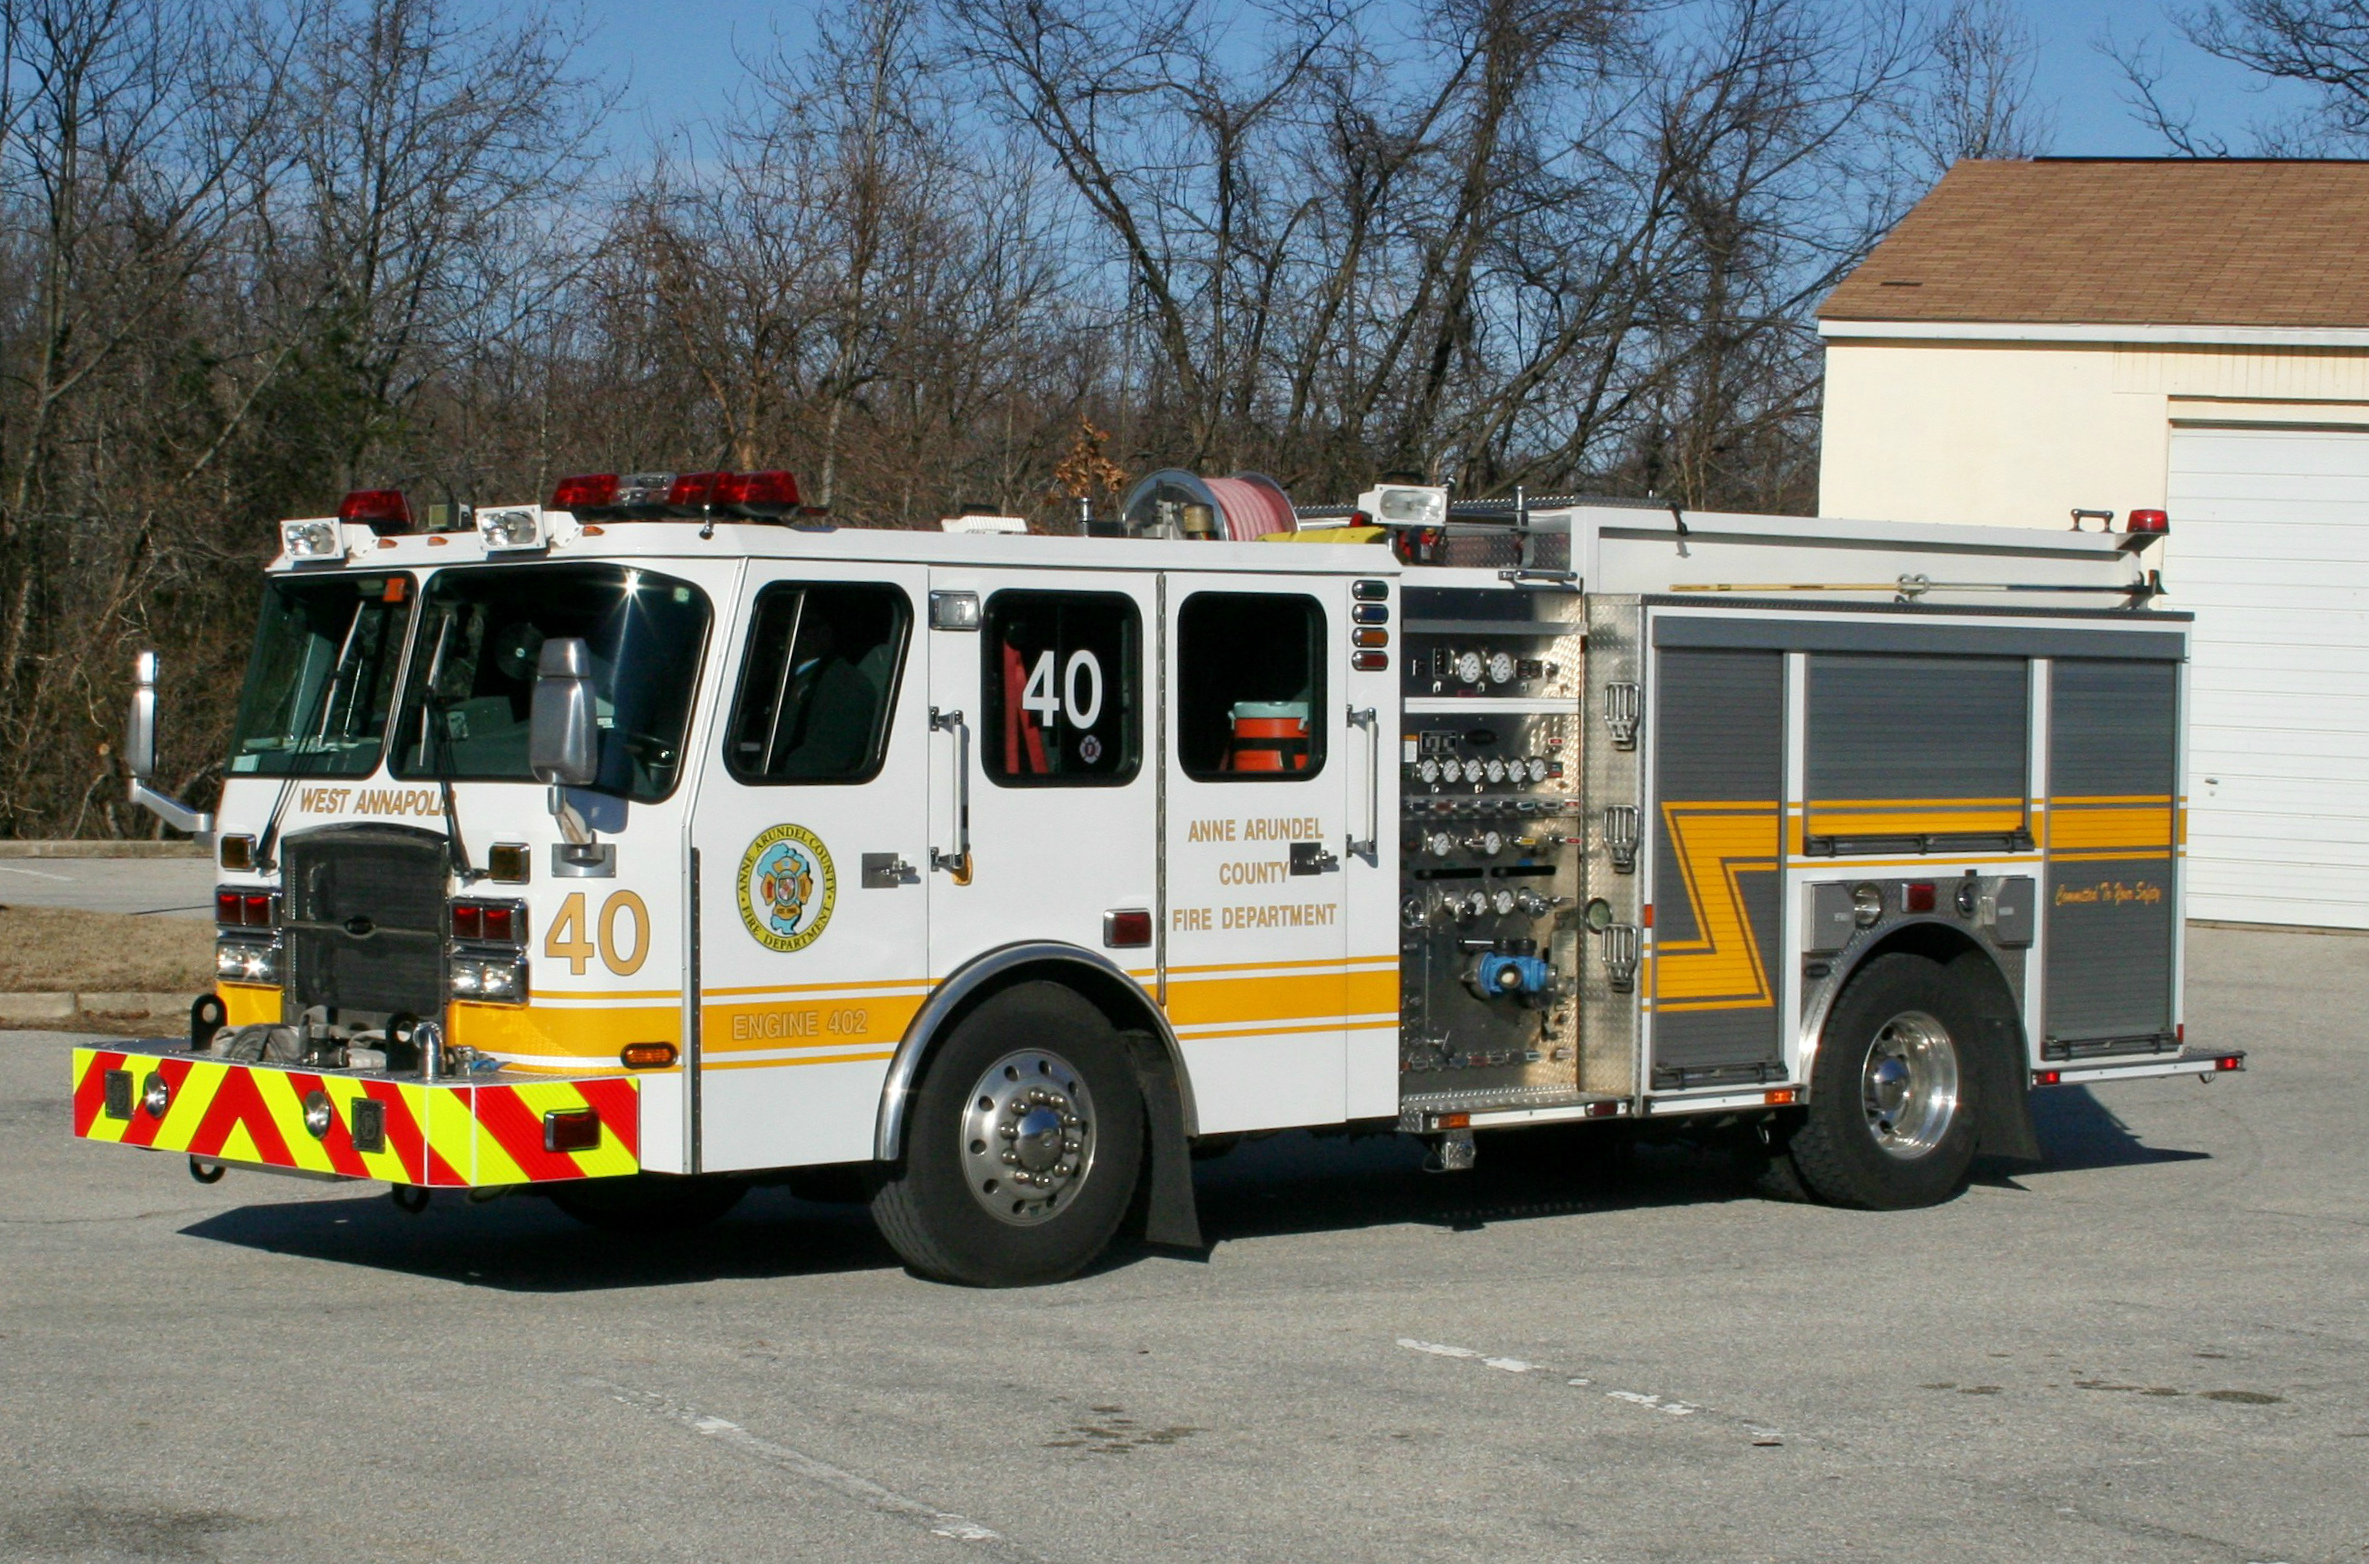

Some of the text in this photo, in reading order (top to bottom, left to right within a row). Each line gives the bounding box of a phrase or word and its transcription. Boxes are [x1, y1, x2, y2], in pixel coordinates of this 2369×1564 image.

[1022, 649, 1102, 729] 40
[300, 788, 350, 814] WEST
[1188, 817, 1324, 842] ANNE ARUNDEL
[739, 826, 836, 894] ANNE ARUNDEL COUNTY
[1219, 861, 1289, 886] COUNTY
[544, 889, 650, 977] 40
[741, 903, 832, 950] FIRE DEPARTMENT
[1173, 903, 1337, 931] FIRE DEPARTMENT
[732, 1008, 868, 1041] ENGINE 402
